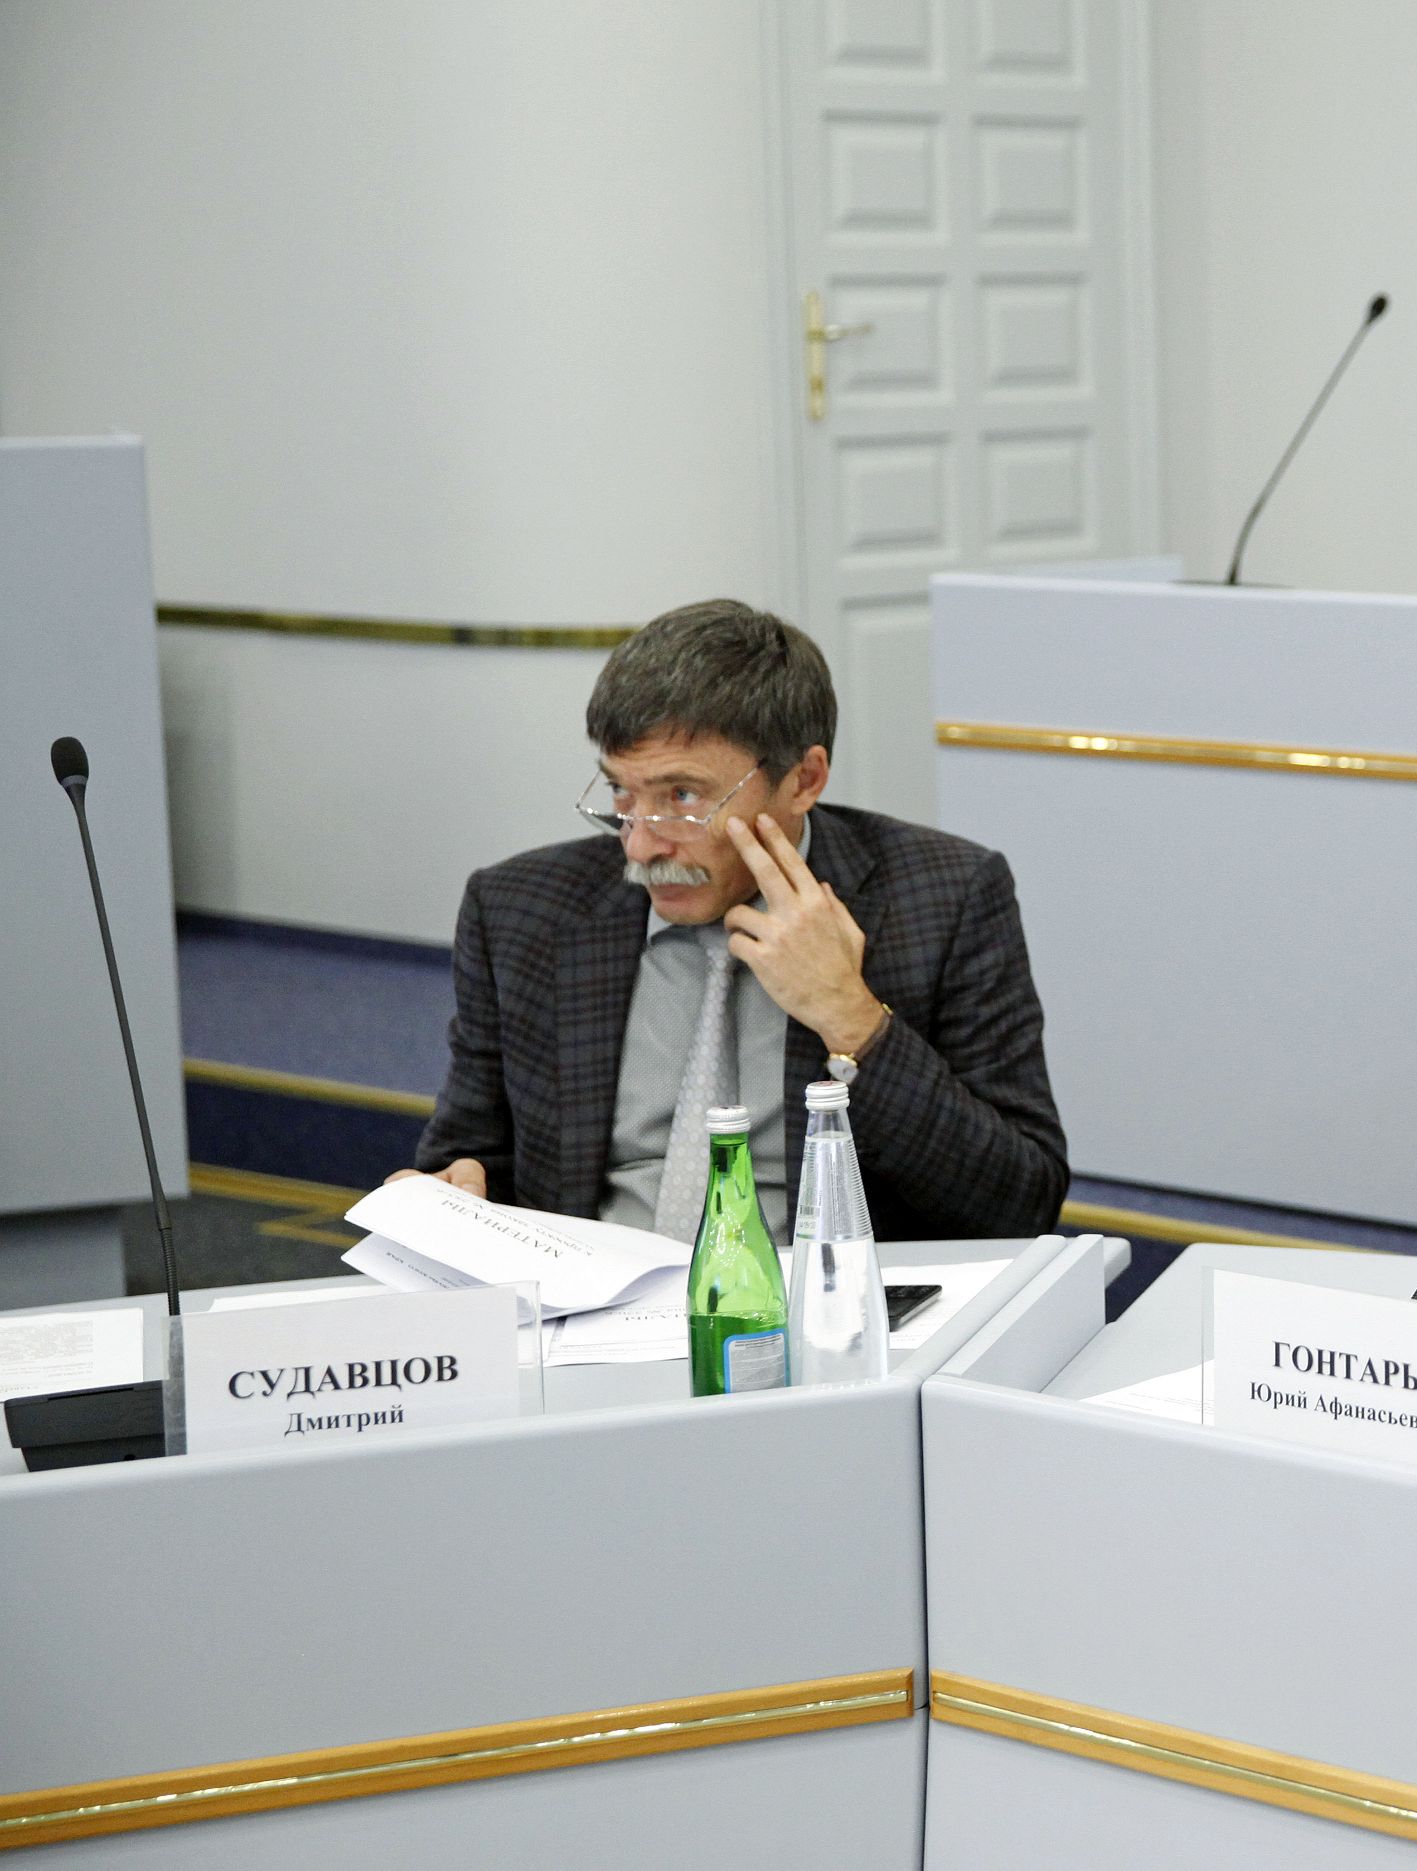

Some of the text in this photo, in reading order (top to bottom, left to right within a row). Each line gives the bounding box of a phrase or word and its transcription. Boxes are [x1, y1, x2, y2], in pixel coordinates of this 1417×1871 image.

[440, 1199, 564, 1259] МАТЕРИАЛЫ
[228, 1354, 460, 1402] СУДАВЦОВ
[1250, 1381, 1308, 1410] Юрий
[284, 1404, 405, 1438] Дмитрий
